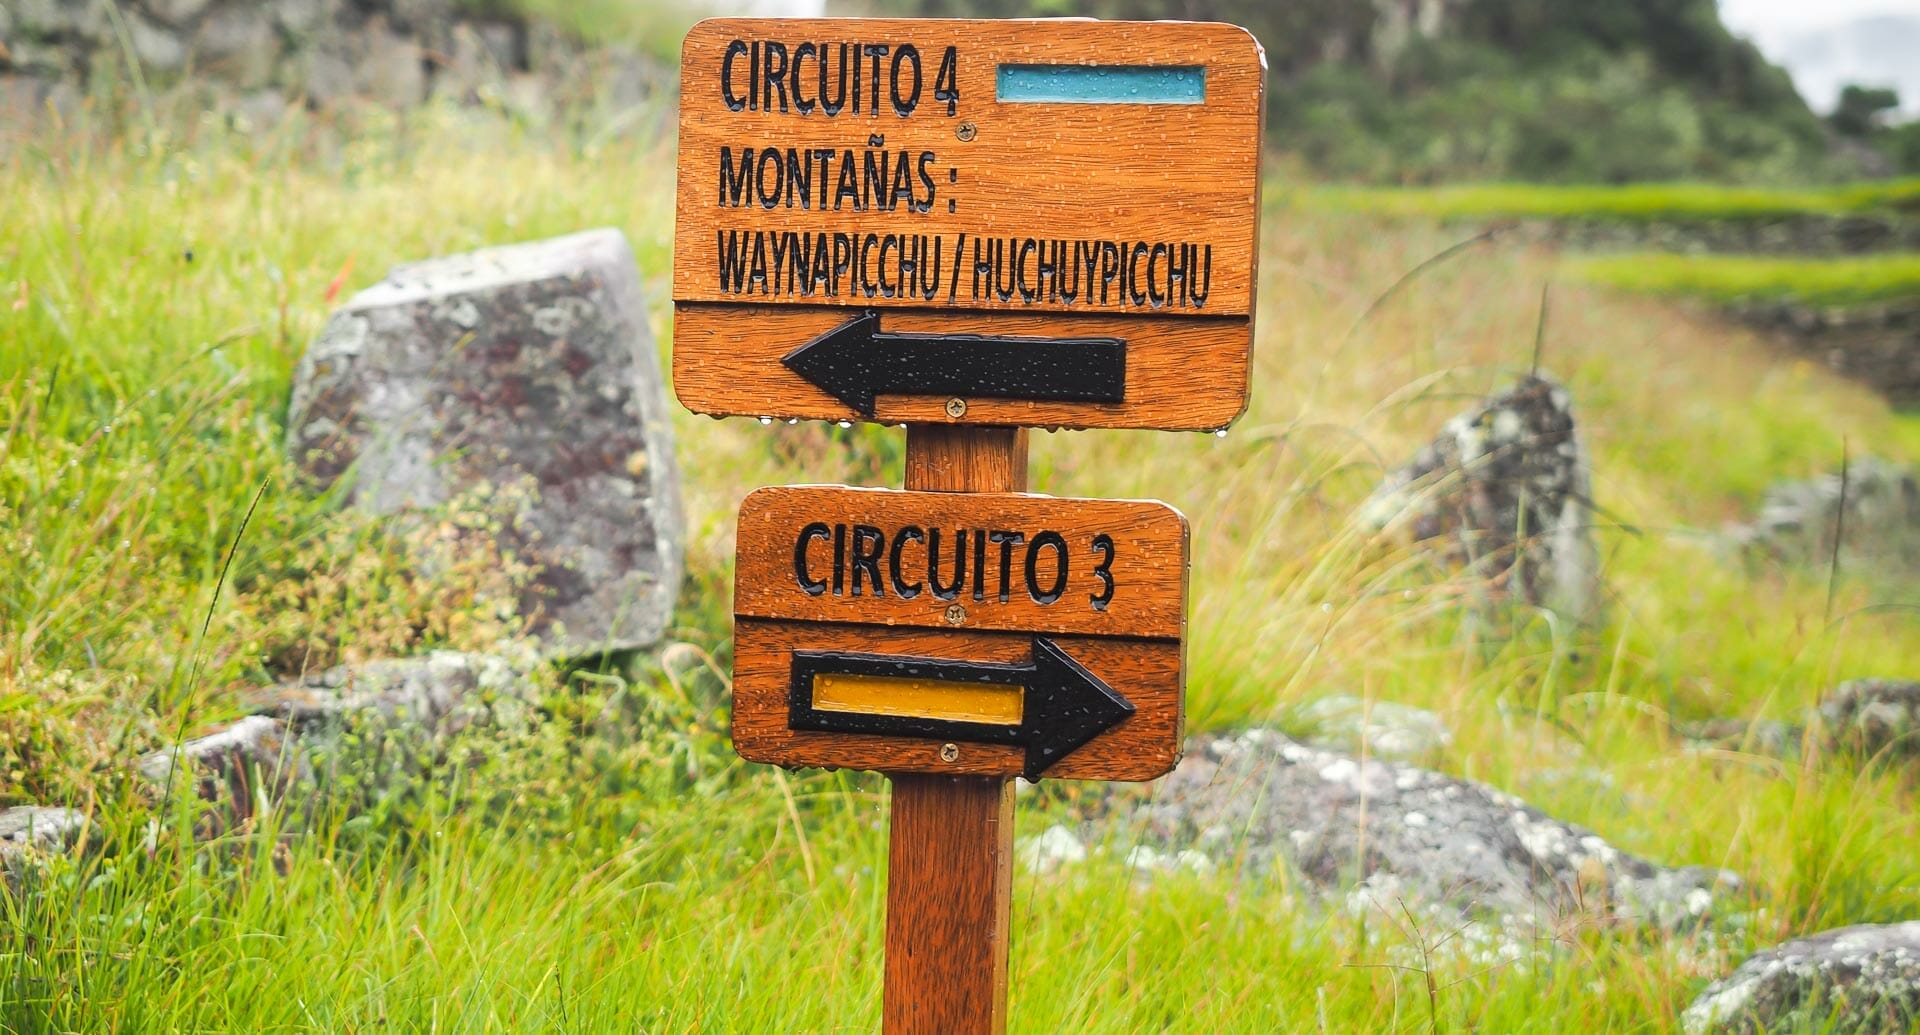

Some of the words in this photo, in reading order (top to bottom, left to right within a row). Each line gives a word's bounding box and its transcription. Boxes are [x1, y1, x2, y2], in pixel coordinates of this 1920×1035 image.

[721, 39, 923, 118] CIRCUITO
[934, 45, 960, 118] 4
[717, 133, 936, 214] MONTAÑAS
[793, 521, 1070, 606] CIRCUITO
[1089, 533, 1118, 612] 3
